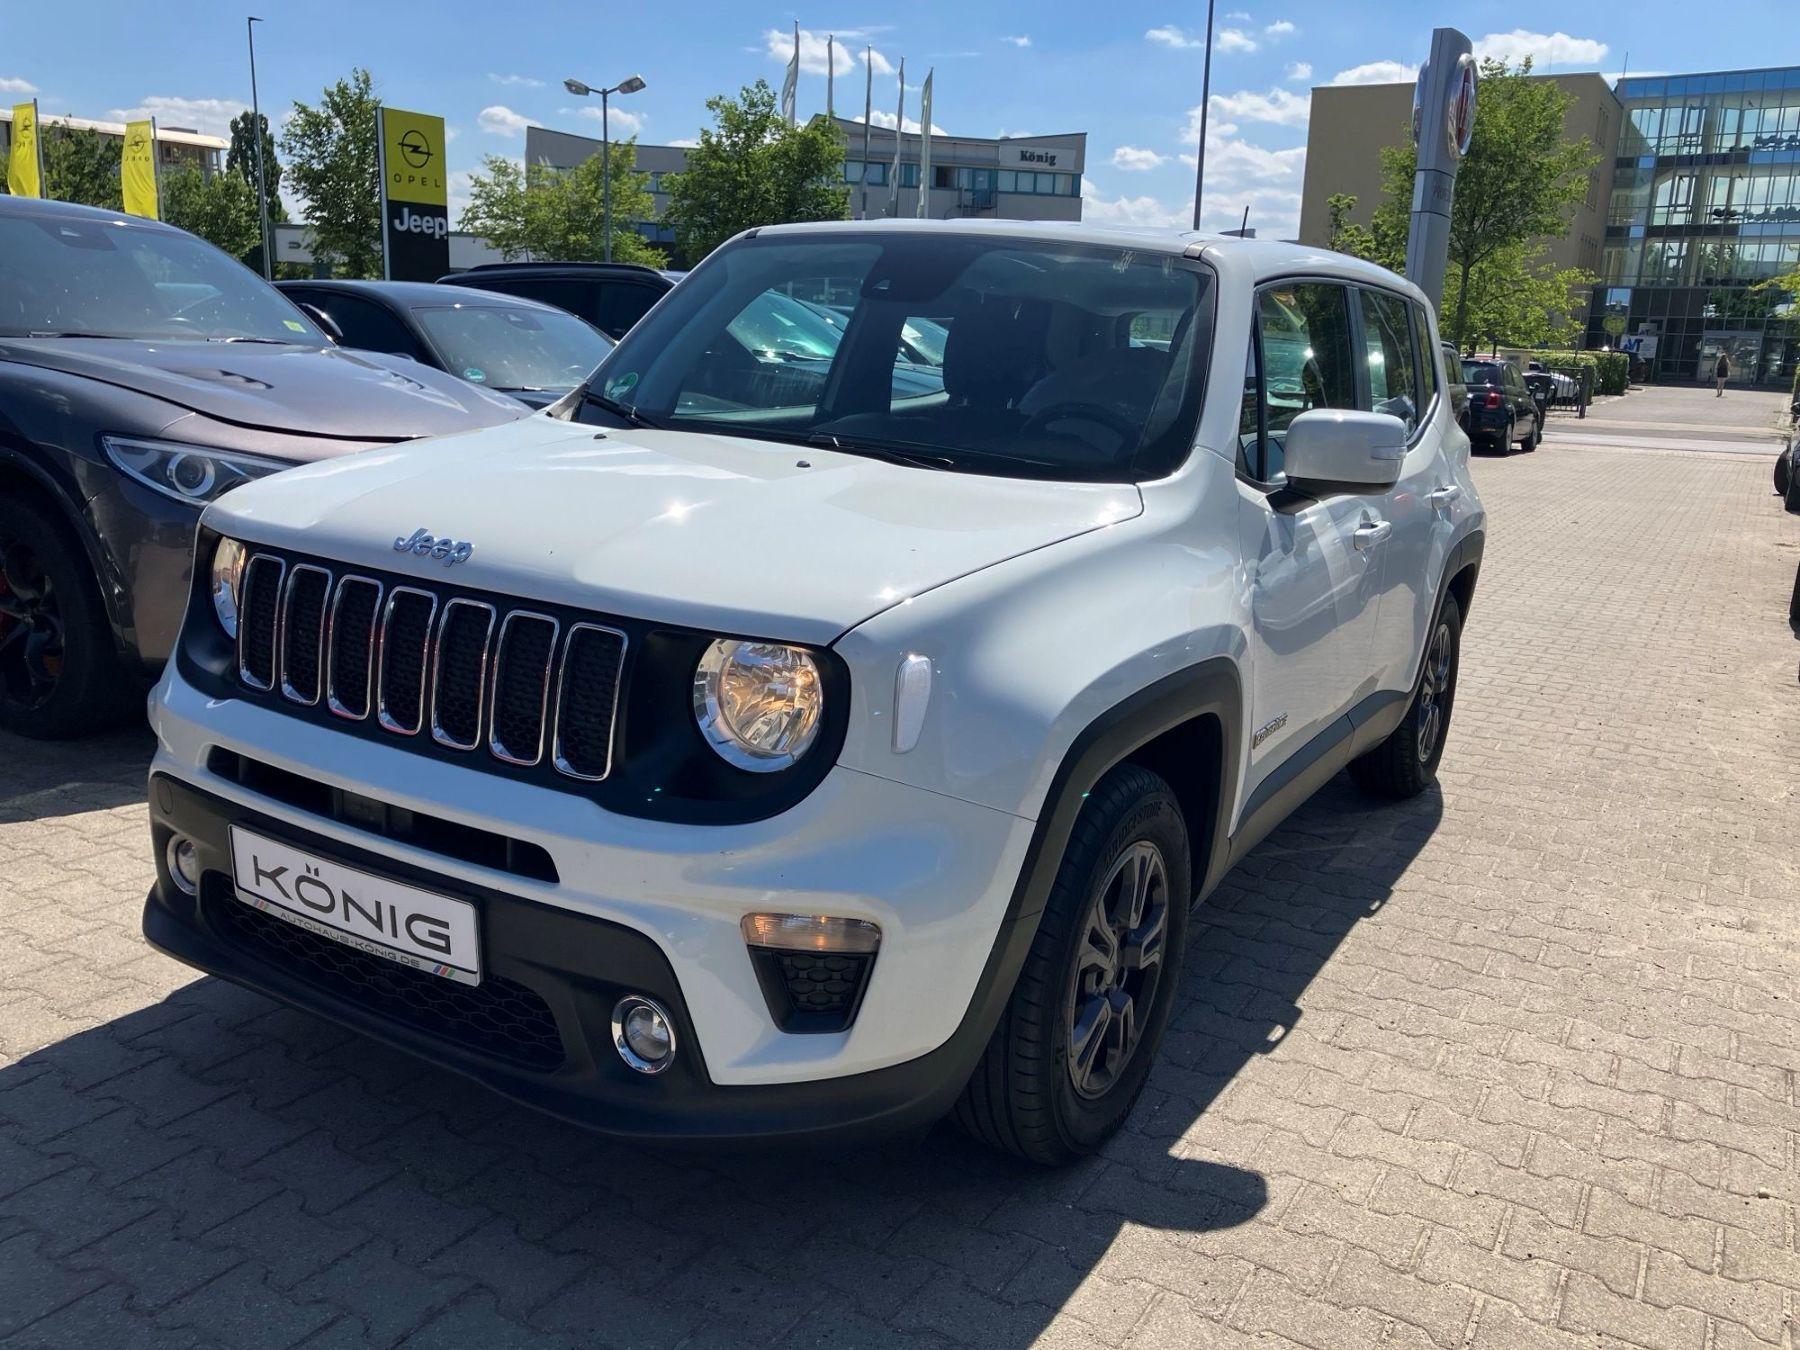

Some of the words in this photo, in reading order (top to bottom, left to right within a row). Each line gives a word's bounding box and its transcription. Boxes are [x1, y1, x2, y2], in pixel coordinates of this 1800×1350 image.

[1020, 150, 1057, 167] König
[393, 172, 441, 188] OPEL
[394, 207, 448, 240] Jeep
[393, 527, 473, 568] Jeep
[252, 855, 452, 956] KÖNIG
